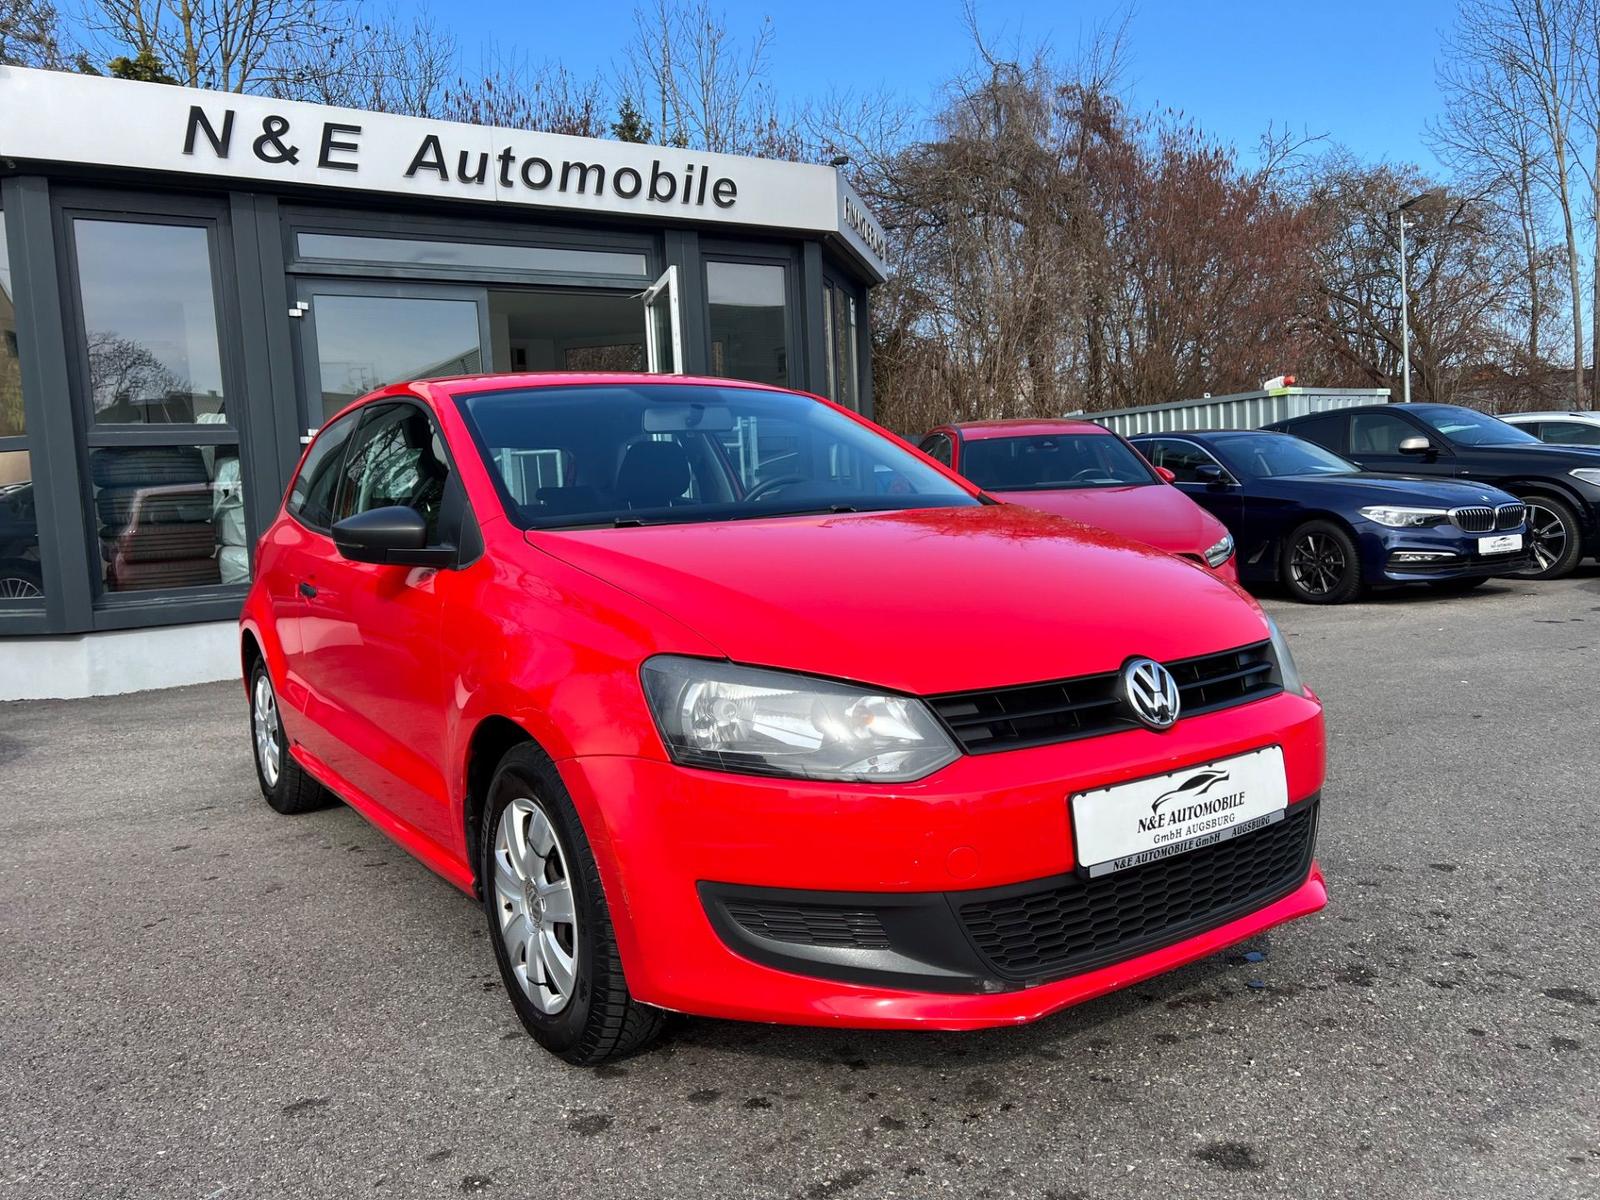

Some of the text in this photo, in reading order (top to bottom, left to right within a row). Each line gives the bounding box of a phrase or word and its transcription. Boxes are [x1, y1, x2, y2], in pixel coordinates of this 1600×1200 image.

[181, 105, 738, 209] N&E Automobile
[1137, 791, 1245, 834] N&E AUTOMOBILE
[1153, 813, 1235, 844] GmbH AUGSBURG
[1113, 815, 1270, 871] N&E AUTOMOBILE GmbH AUGSBURG
